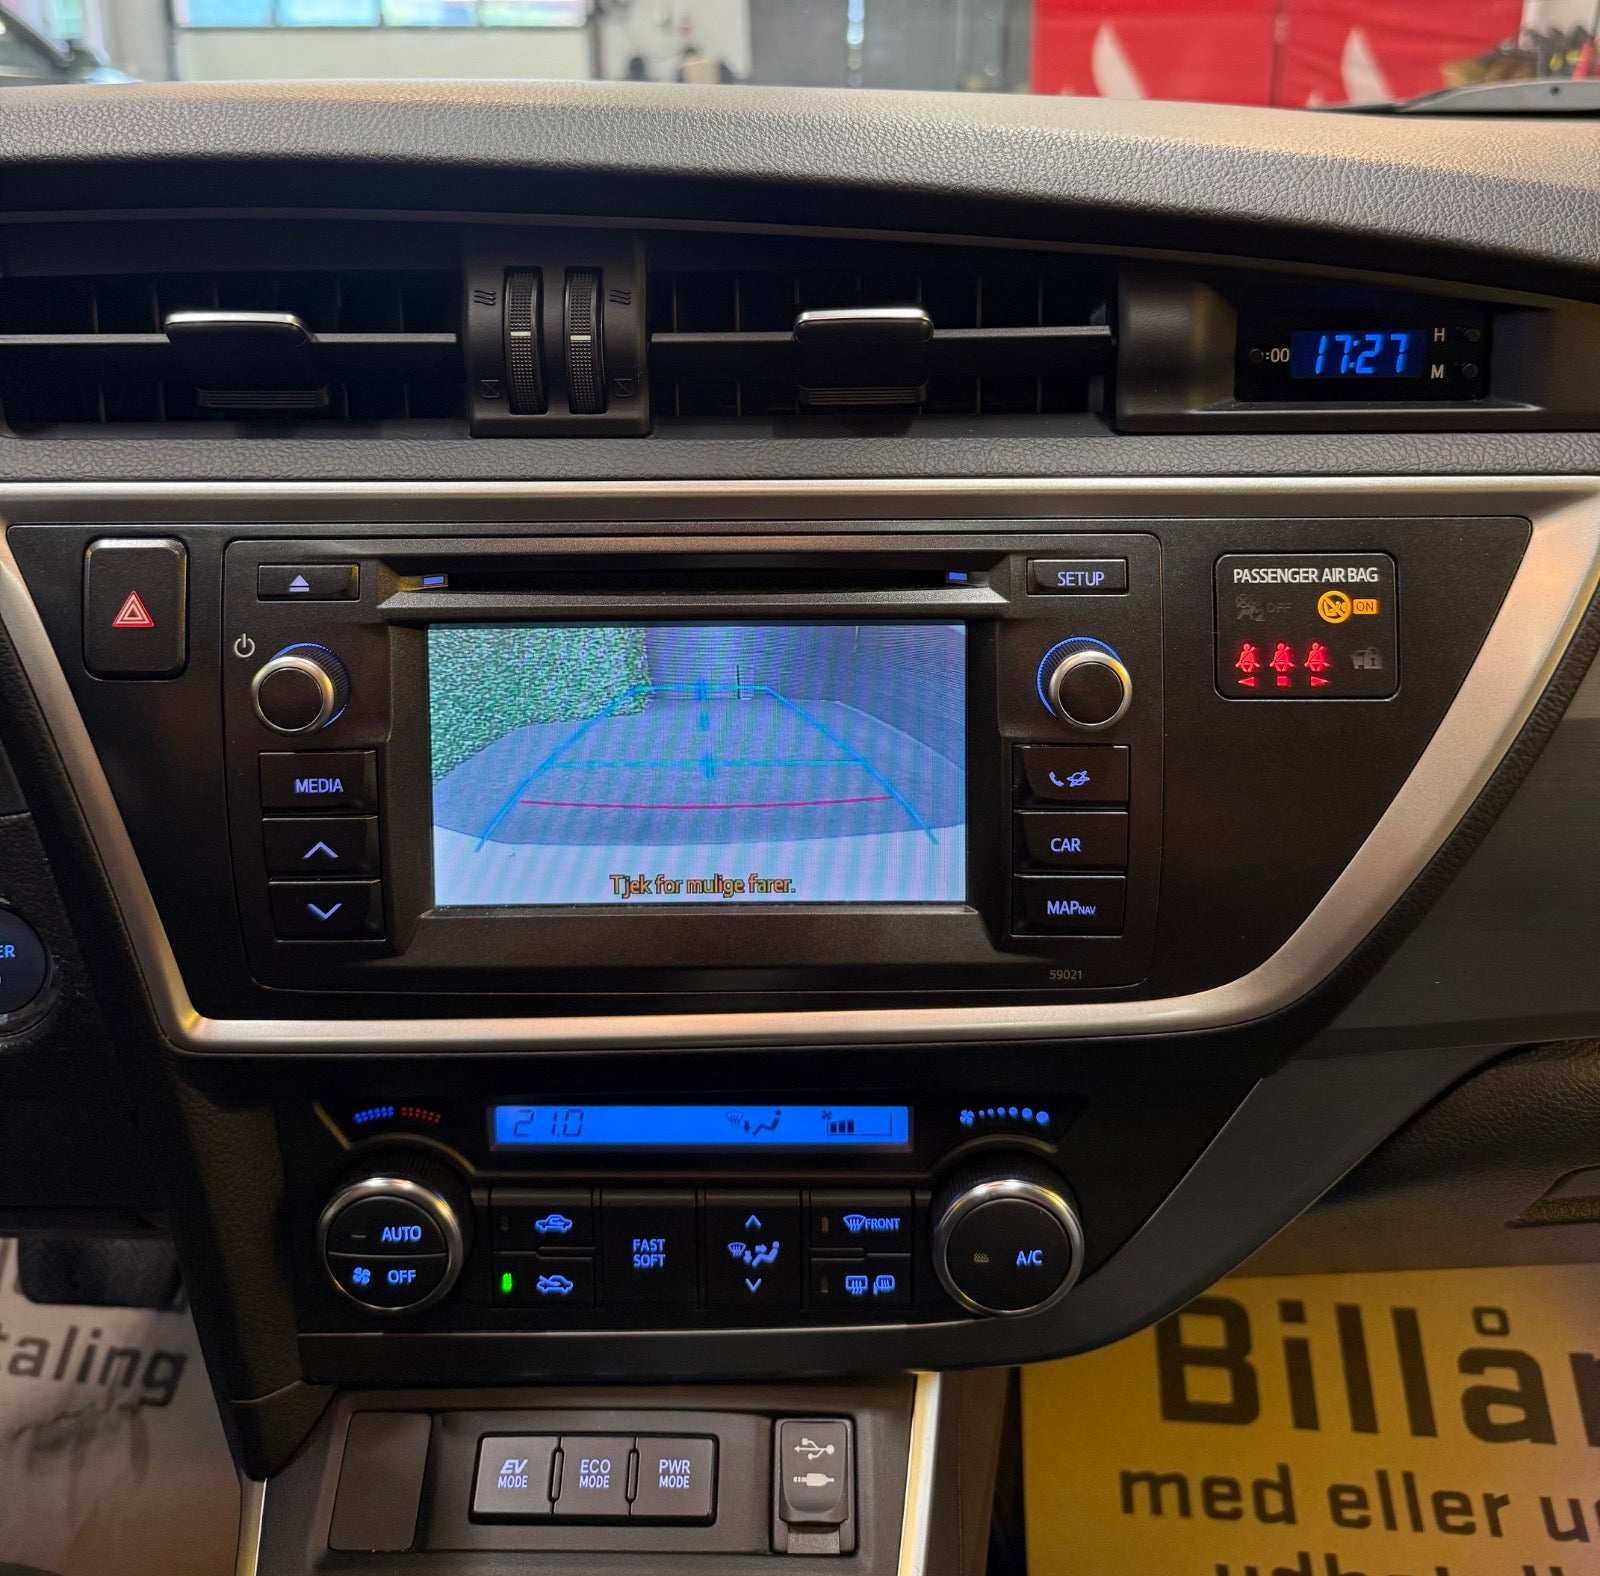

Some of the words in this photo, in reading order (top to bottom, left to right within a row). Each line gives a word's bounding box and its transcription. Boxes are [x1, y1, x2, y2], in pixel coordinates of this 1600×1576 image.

[1433, 327, 1446, 342] H
[1315, 333, 1409, 375] 17:27
[1430, 364, 1445, 379] M
[1057, 571, 1105, 587] SETUP
[1233, 568, 1318, 584] PASSENGER
[1321, 568, 1346, 583] AIR
[1347, 567, 1379, 582] BAG
[1356, 601, 1374, 612] ON
[294, 778, 344, 793] MEDIA
[1050, 837, 1081, 853] CAR
[609, 873, 653, 899] Tjek
[655, 873, 683, 894] for
[686, 873, 745, 898] mulige
[749, 873, 796, 894] farer.
[1049, 969, 1083, 980] 59021
[865, 1217, 900, 1231] FRONT
[381, 1225, 422, 1242] AUTO
[632, 1238, 666, 1252] FAST
[633, 1253, 666, 1268] SOFT
[1016, 1249, 1044, 1266] A/C
[387, 1269, 417, 1285] OFF
[500, 1459, 529, 1474] EV
[580, 1459, 611, 1474] ECO
[658, 1459, 691, 1474] PWR
[497, 1475, 529, 1489] MODE
[578, 1475, 610, 1489] MODE
[659, 1475, 690, 1489] MODE
[1119, 1462, 1296, 1525] med
[1326, 1469, 1510, 1538] eller
[1539, 1496, 1600, 1543] u
